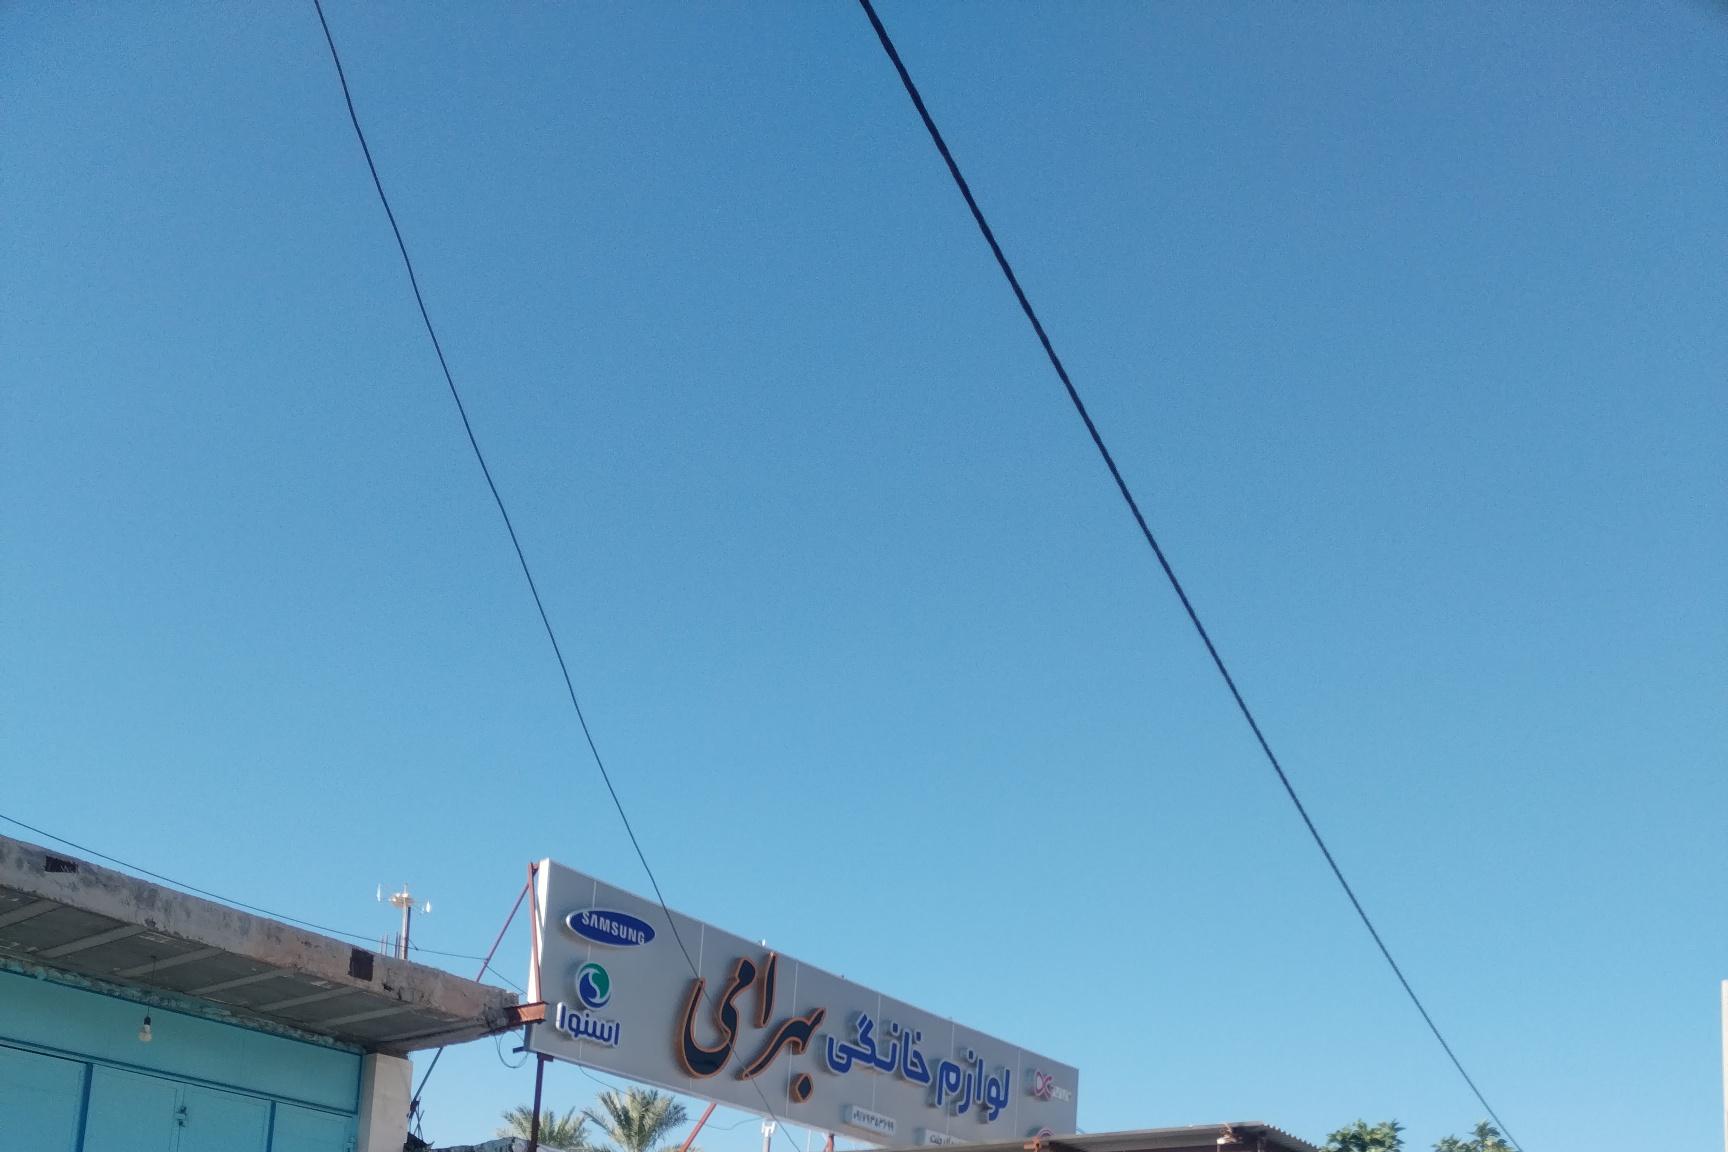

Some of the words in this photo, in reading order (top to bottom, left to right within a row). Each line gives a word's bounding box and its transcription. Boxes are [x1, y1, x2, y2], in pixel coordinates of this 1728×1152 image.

[581, 910, 646, 945] SAMSUNG
[556, 1002, 621, 1048] اسنوا
[679, 952, 826, 1103] بهرامی
[826, 1012, 931, 1086] خانگی
[937, 1051, 1011, 1123] لوازم
